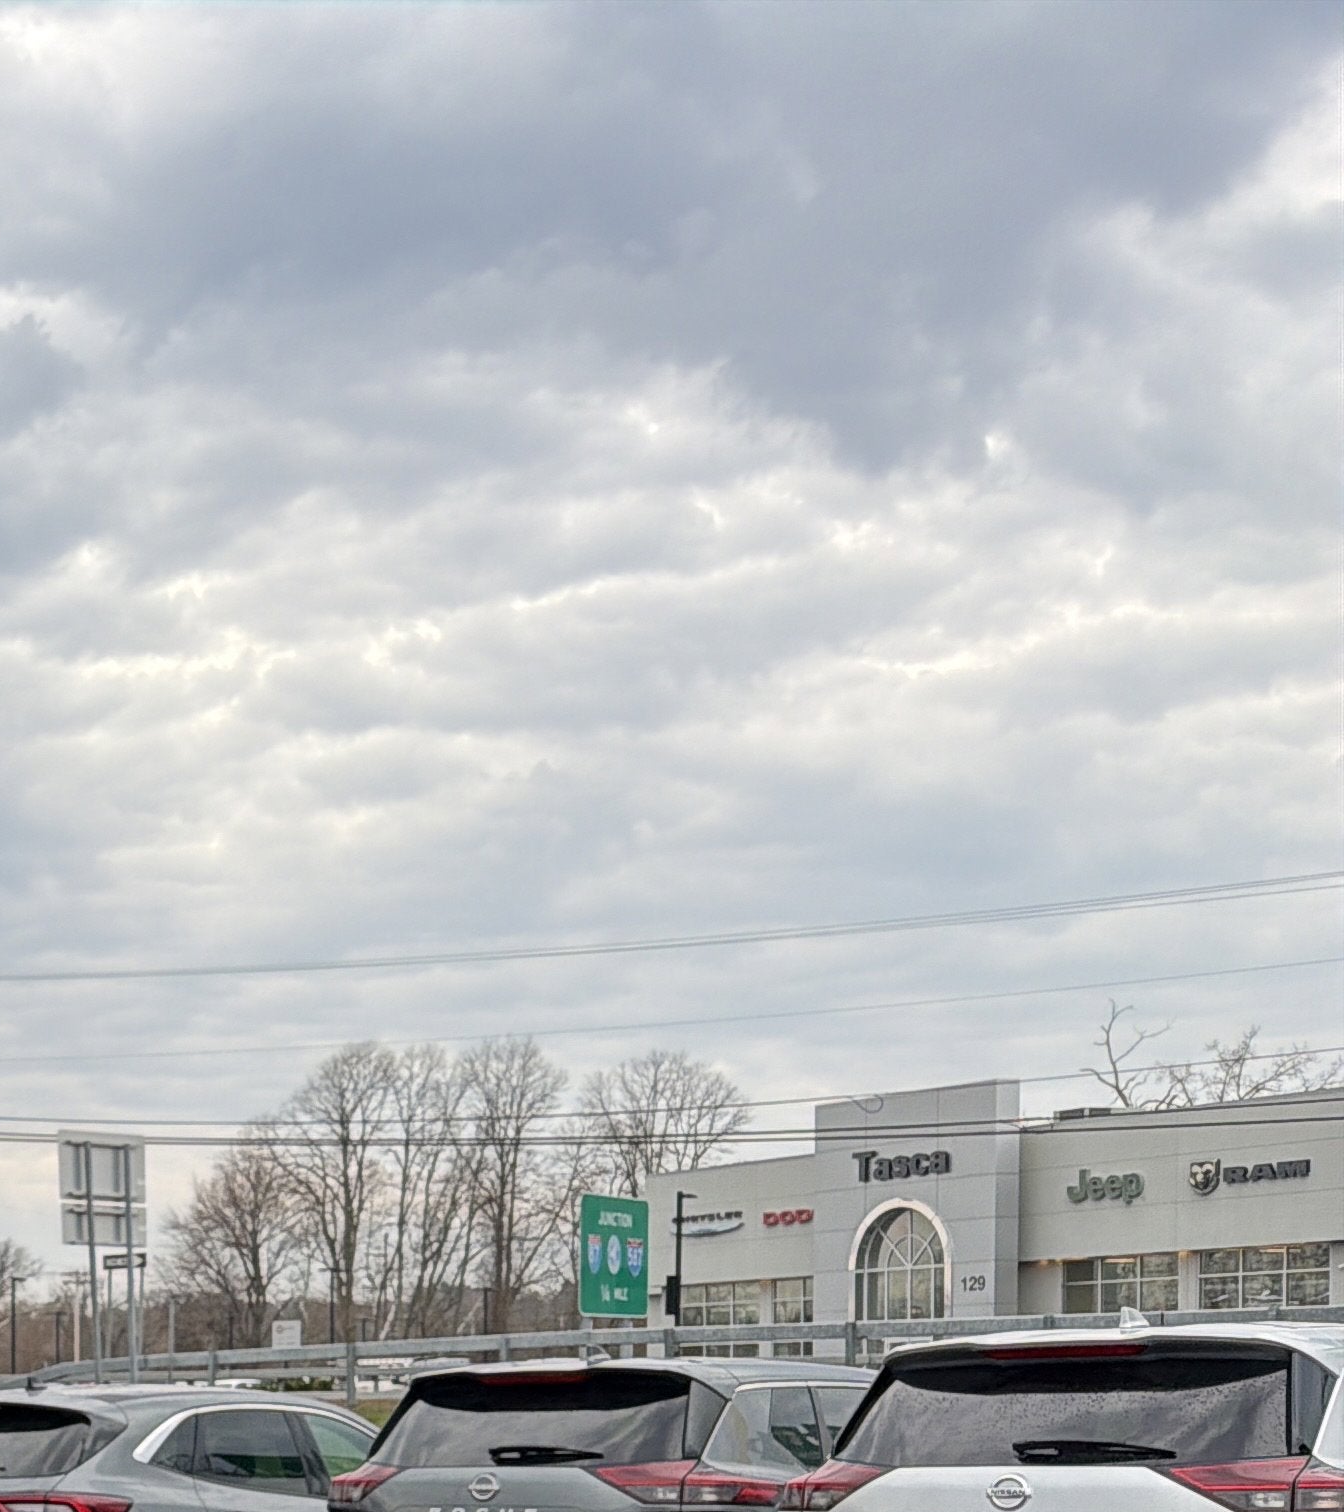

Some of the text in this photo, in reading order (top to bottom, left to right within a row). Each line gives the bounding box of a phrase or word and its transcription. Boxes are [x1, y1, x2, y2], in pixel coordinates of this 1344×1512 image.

[852, 1151, 952, 1183] Tasca
[1223, 1159, 1311, 1185] RAM
[1066, 1168, 1144, 1205] Jeep
[961, 1275, 986, 1292] 129
